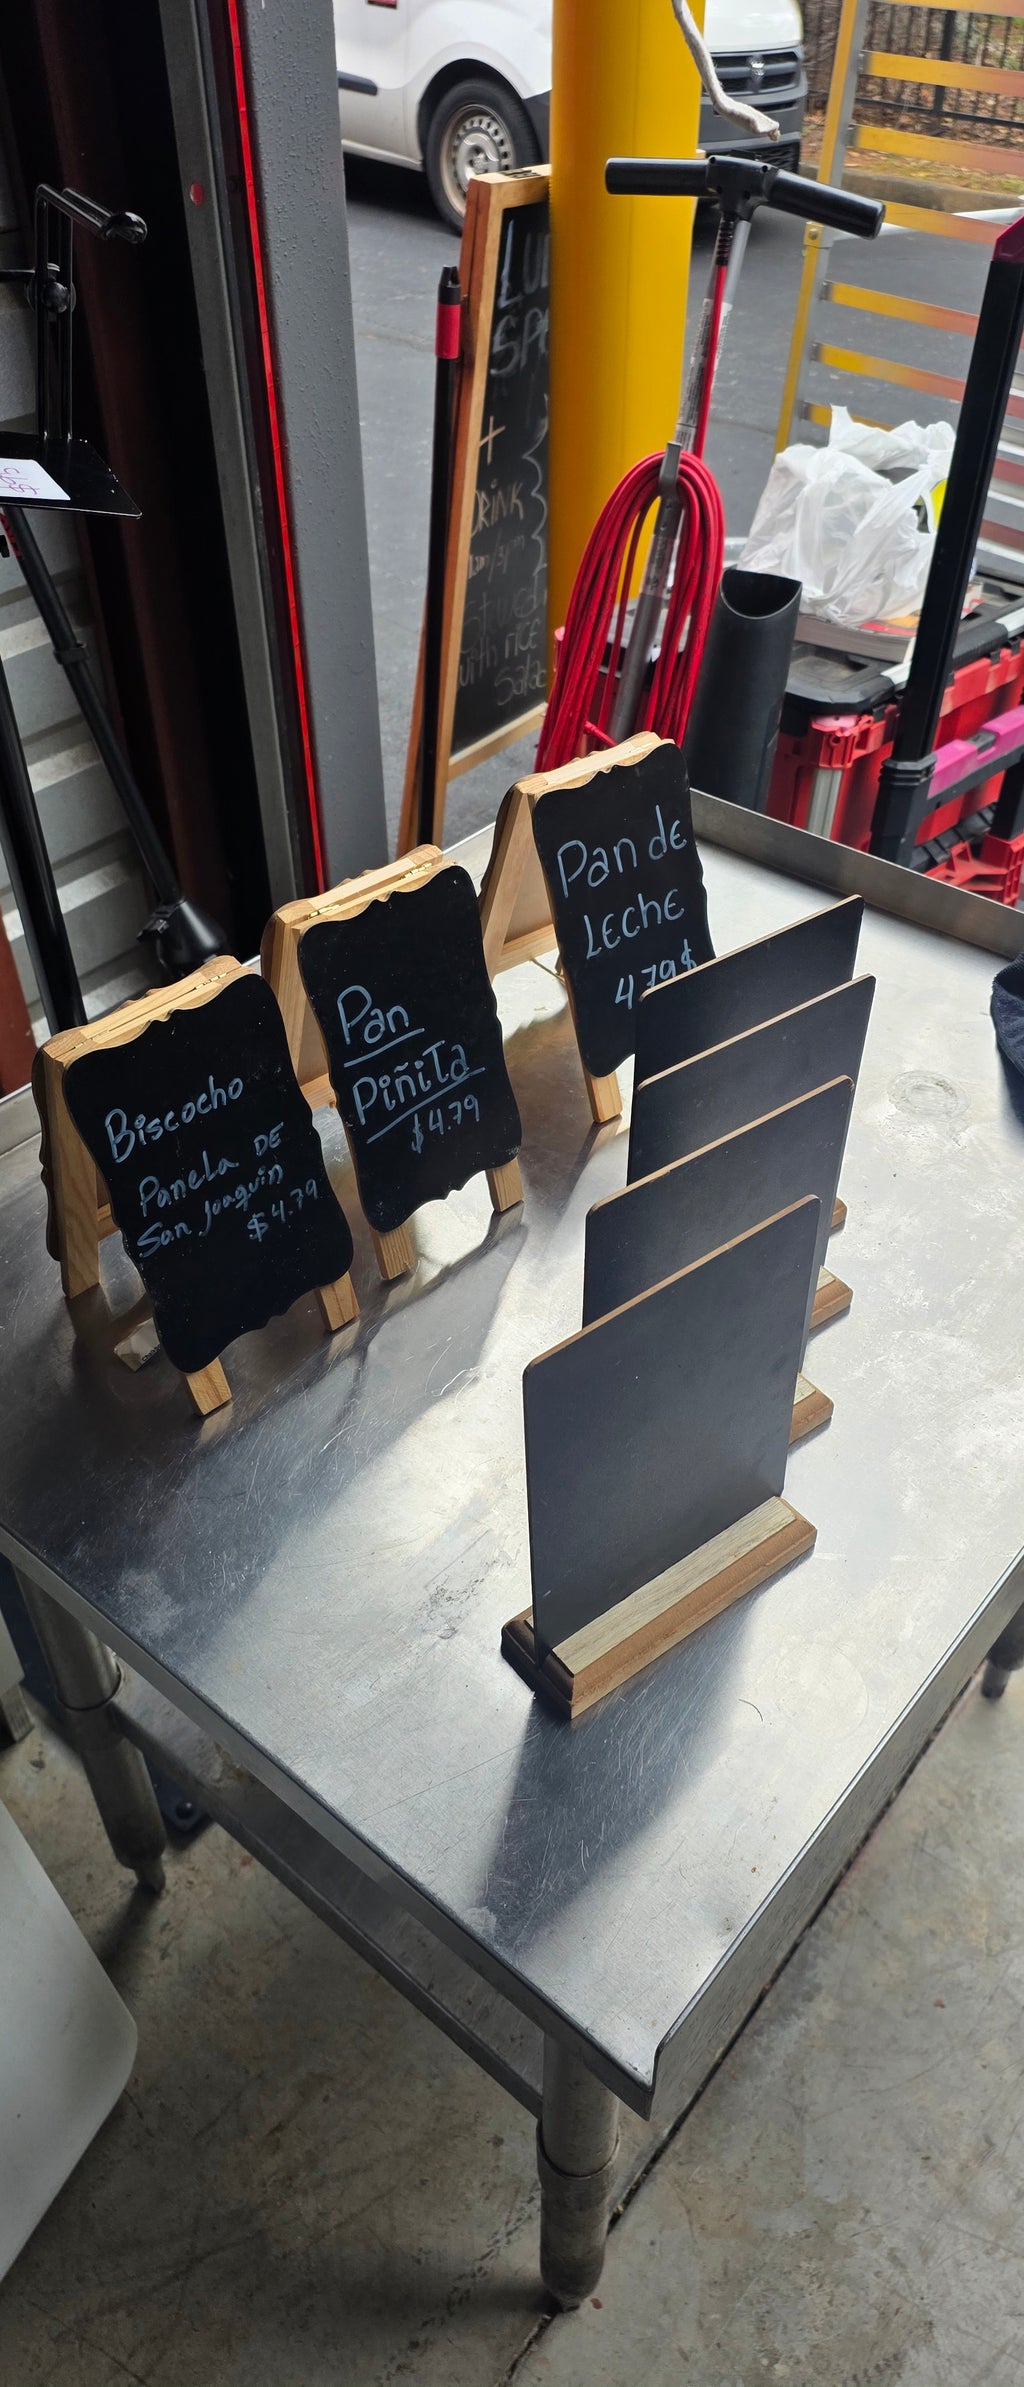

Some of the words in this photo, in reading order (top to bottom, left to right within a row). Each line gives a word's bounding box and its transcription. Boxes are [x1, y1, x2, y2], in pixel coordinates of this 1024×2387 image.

[556, 838, 638, 899] Pan
[336, 984, 410, 1045] Pan
[104, 1074, 244, 1163] Biscocho
[253, 1121, 284, 1157] DE
[411, 1094, 480, 1154] $4.79
[137, 1221, 192, 1258] San
[247, 1178, 319, 1242] $4.79
